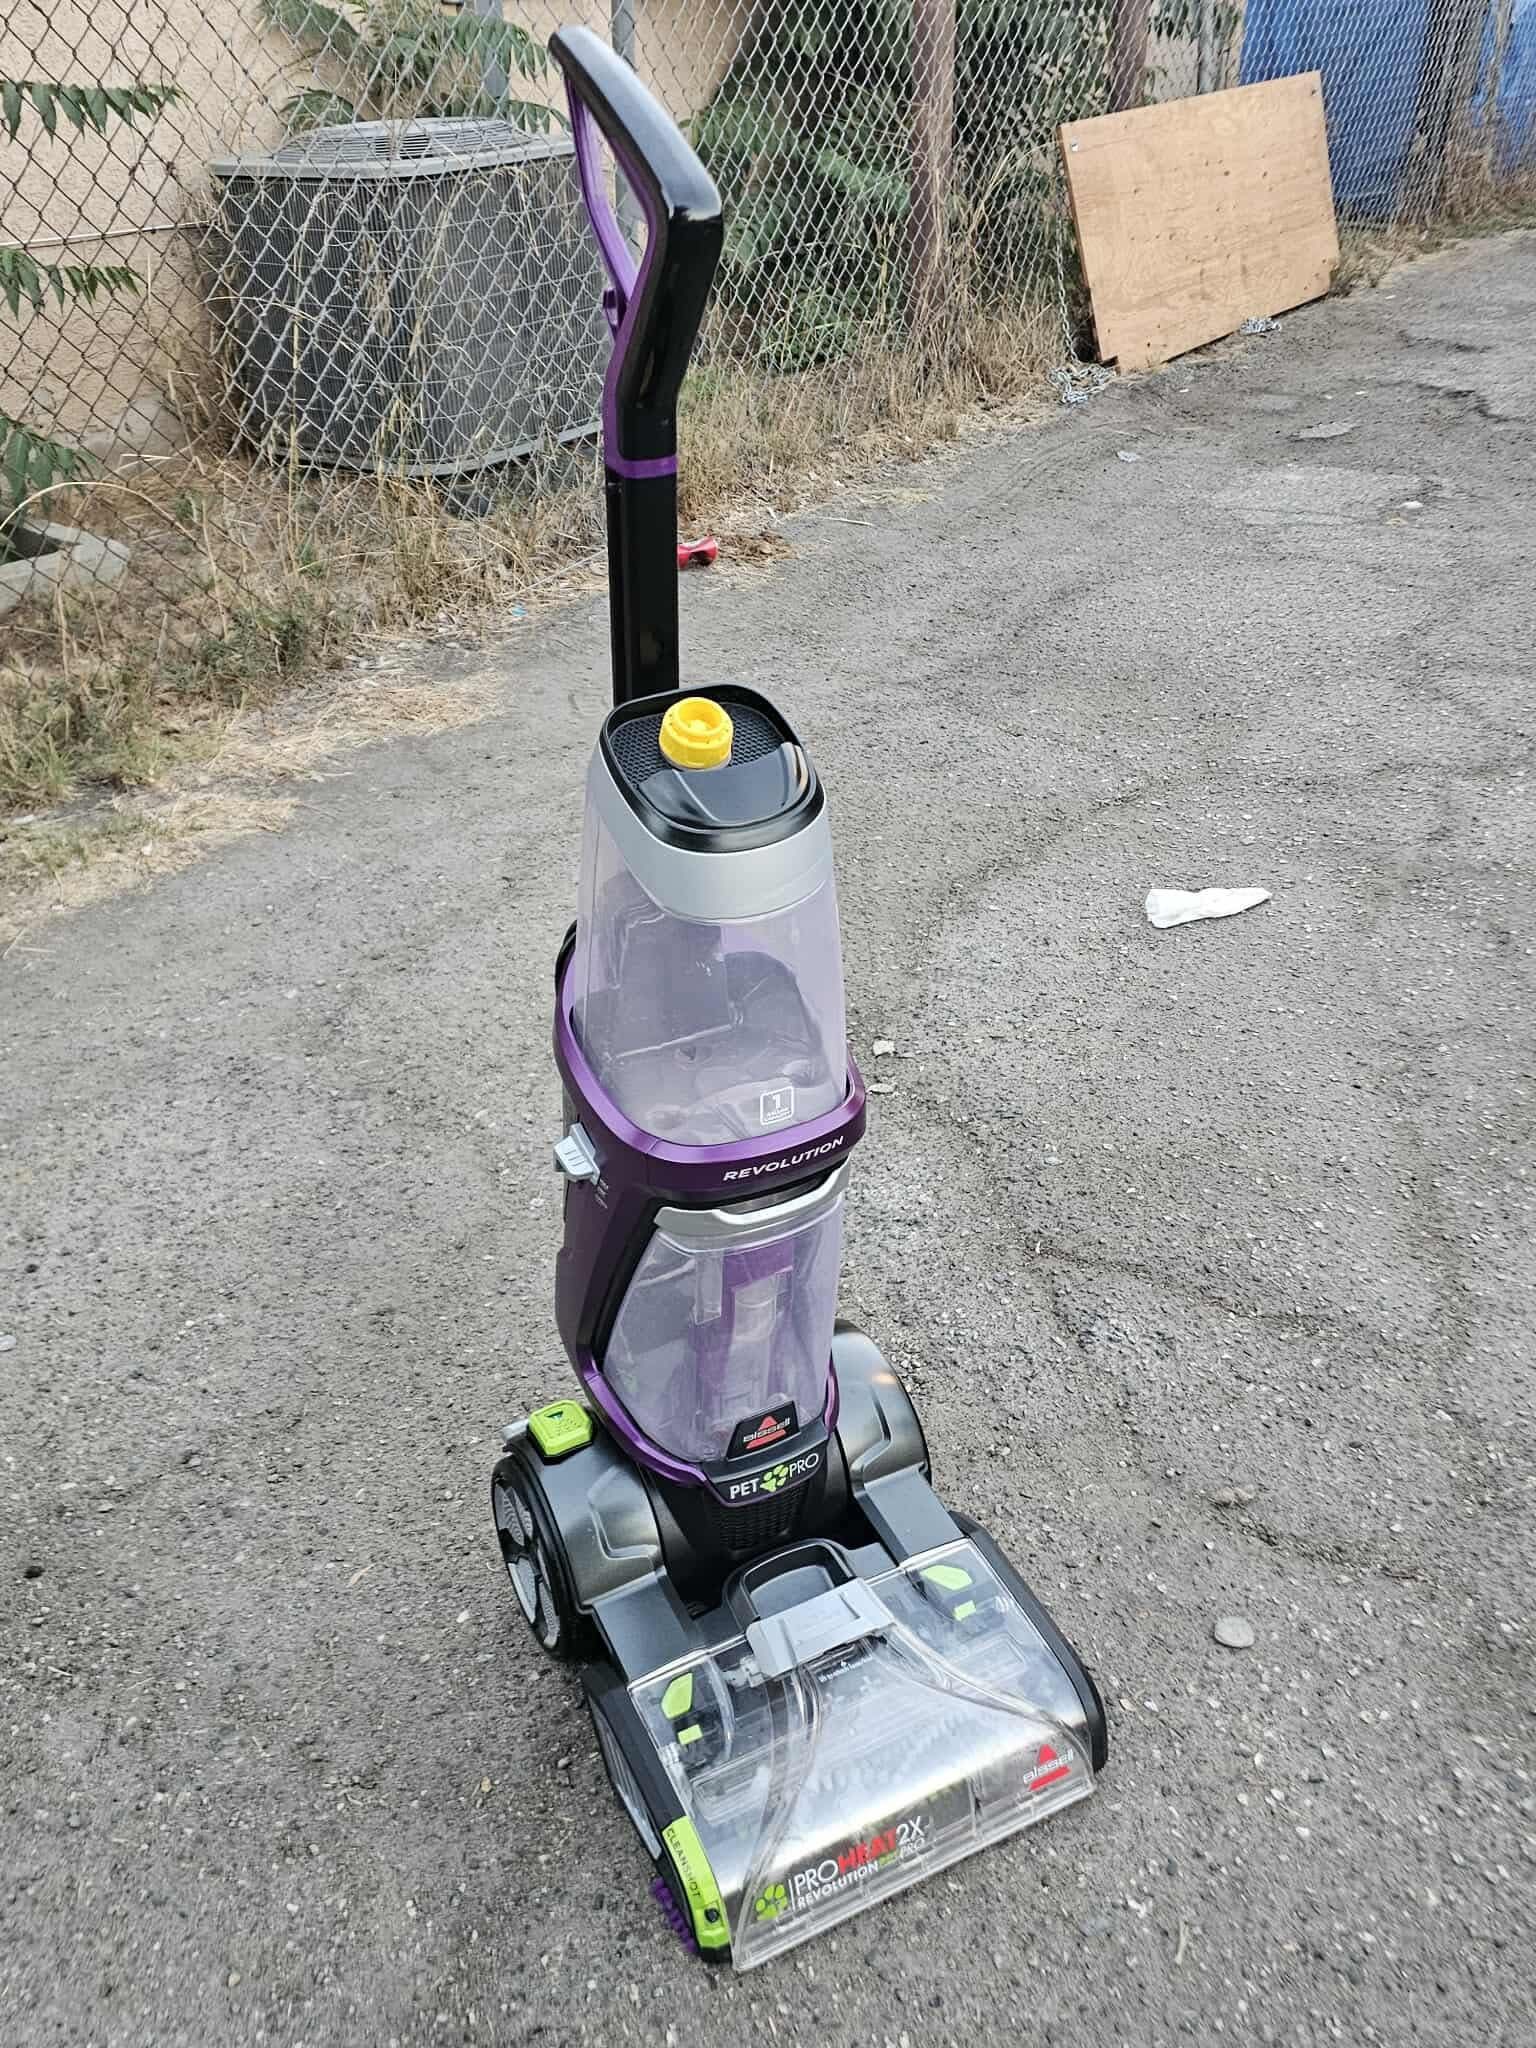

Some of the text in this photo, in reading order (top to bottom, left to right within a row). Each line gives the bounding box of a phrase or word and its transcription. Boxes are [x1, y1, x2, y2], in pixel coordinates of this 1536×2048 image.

[723, 1135, 844, 1182] REVOLUTION
[729, 1453, 819, 1500] PET PRO
[798, 1860, 879, 1910] REVOLUTION
